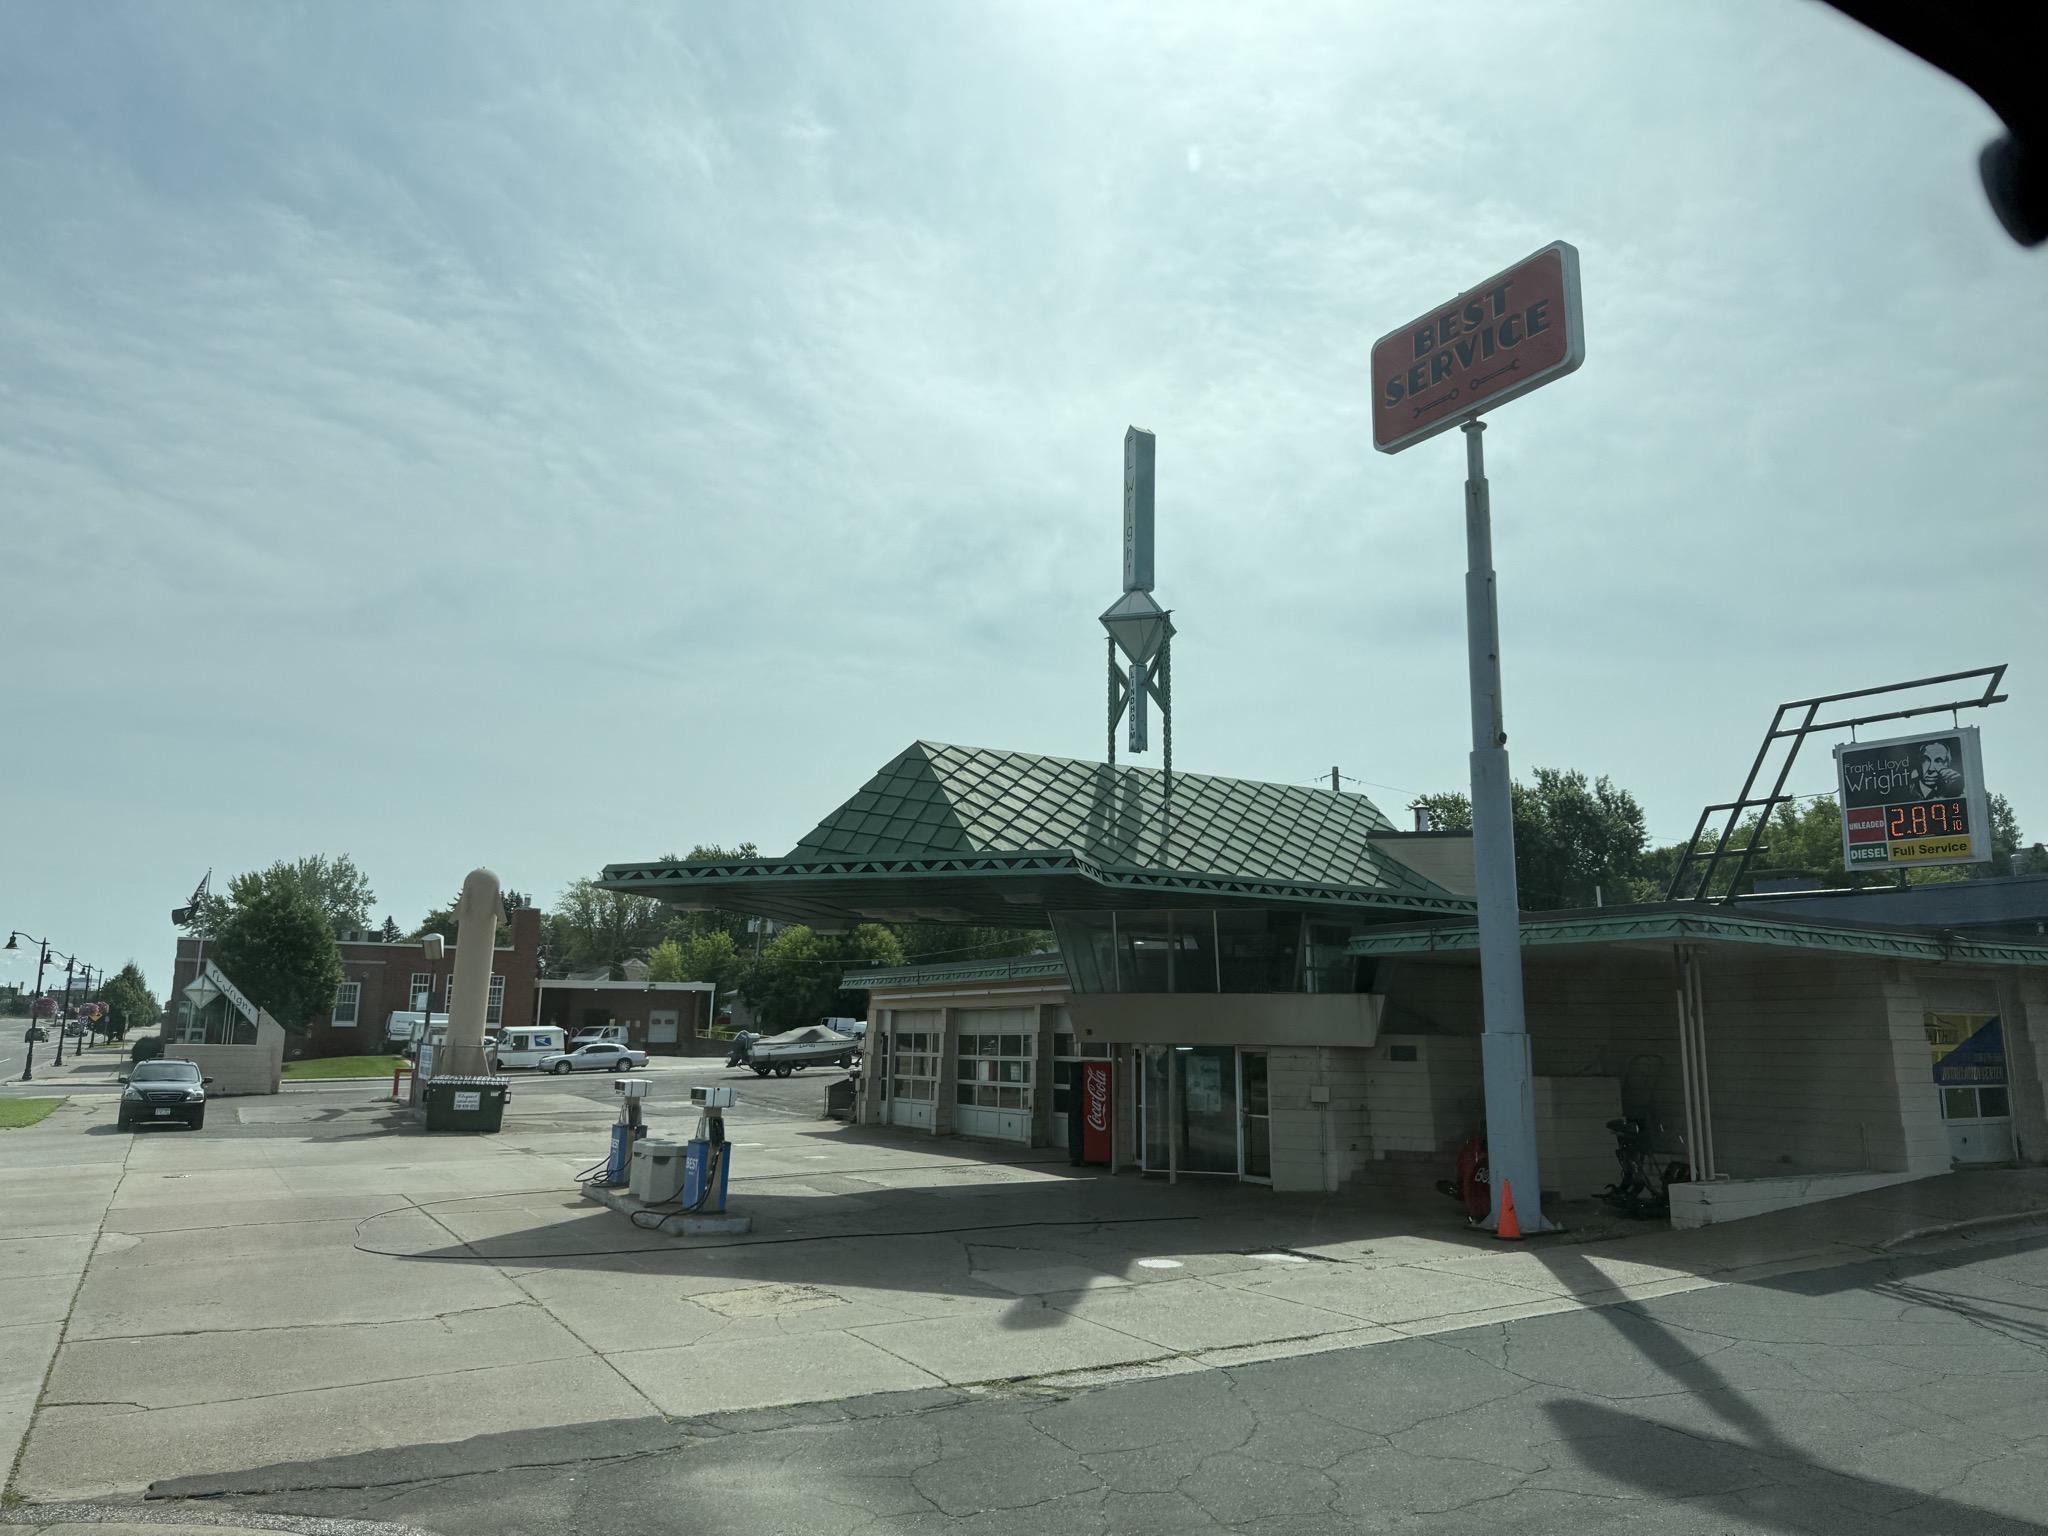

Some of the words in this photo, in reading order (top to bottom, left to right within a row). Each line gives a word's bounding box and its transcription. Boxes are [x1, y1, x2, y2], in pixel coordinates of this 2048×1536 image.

[1413, 279, 1514, 361] BEST
[1384, 298, 1551, 409] SERVICE
[1125, 475, 1135, 576] Wright
[1844, 761, 1875, 774] Frank
[1877, 756, 1910, 773] Lloyd
[1845, 768, 1910, 795] Wright
[1848, 819, 1885, 831] UNLEADED
[1891, 803, 1948, 837] 2.89
[1851, 847, 1887, 860] DIESEL
[1892, 845, 1915, 857] Full
[1918, 842, 1968, 855] Service
[222, 983, 252, 1015] Wright
[685, 1156, 699, 1171] BEST
[1474, 1166, 1490, 1184] BO
